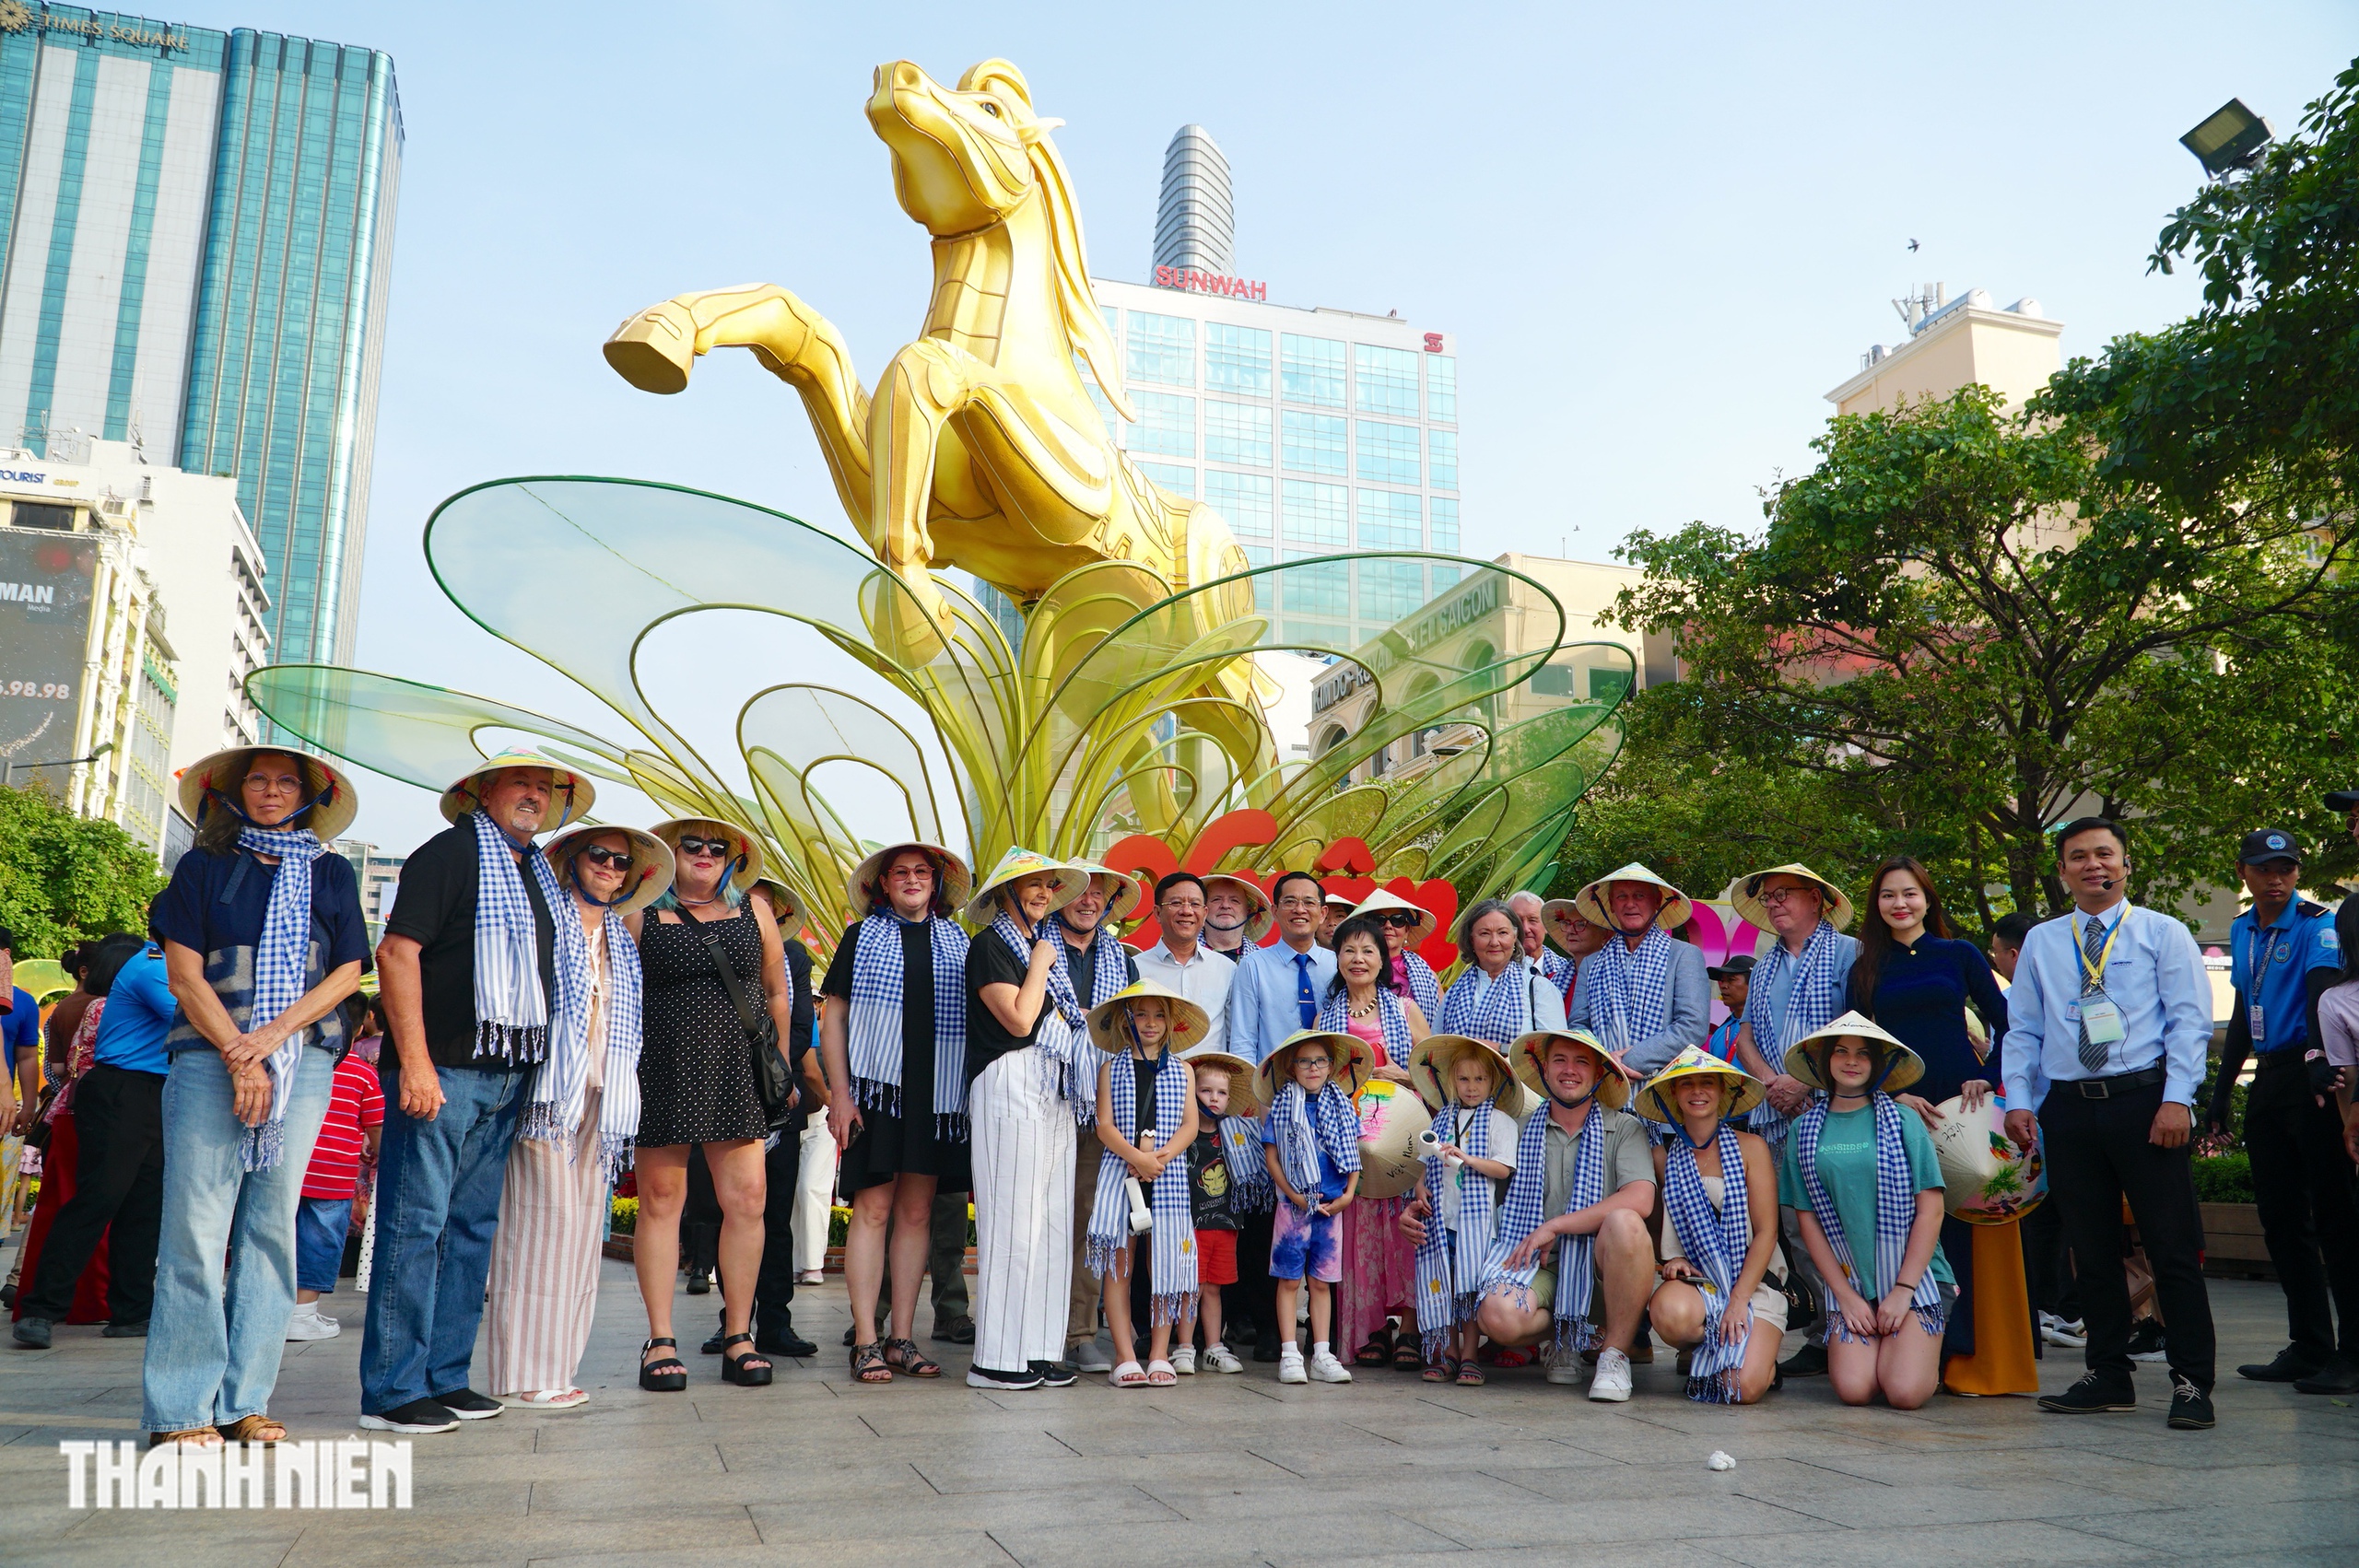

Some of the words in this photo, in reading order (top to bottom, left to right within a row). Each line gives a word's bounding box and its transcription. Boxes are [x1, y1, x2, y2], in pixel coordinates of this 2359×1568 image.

[42, 12, 103, 35] TIMES
[109, 25, 189, 49] SQUARE
[1156, 265, 1267, 301] SUNWAH
[27, 603, 51, 613] Media
[1314, 683, 1332, 713] KIM
[1405, 617, 1437, 652] TEL
[1439, 579, 1496, 636] SAIGON
